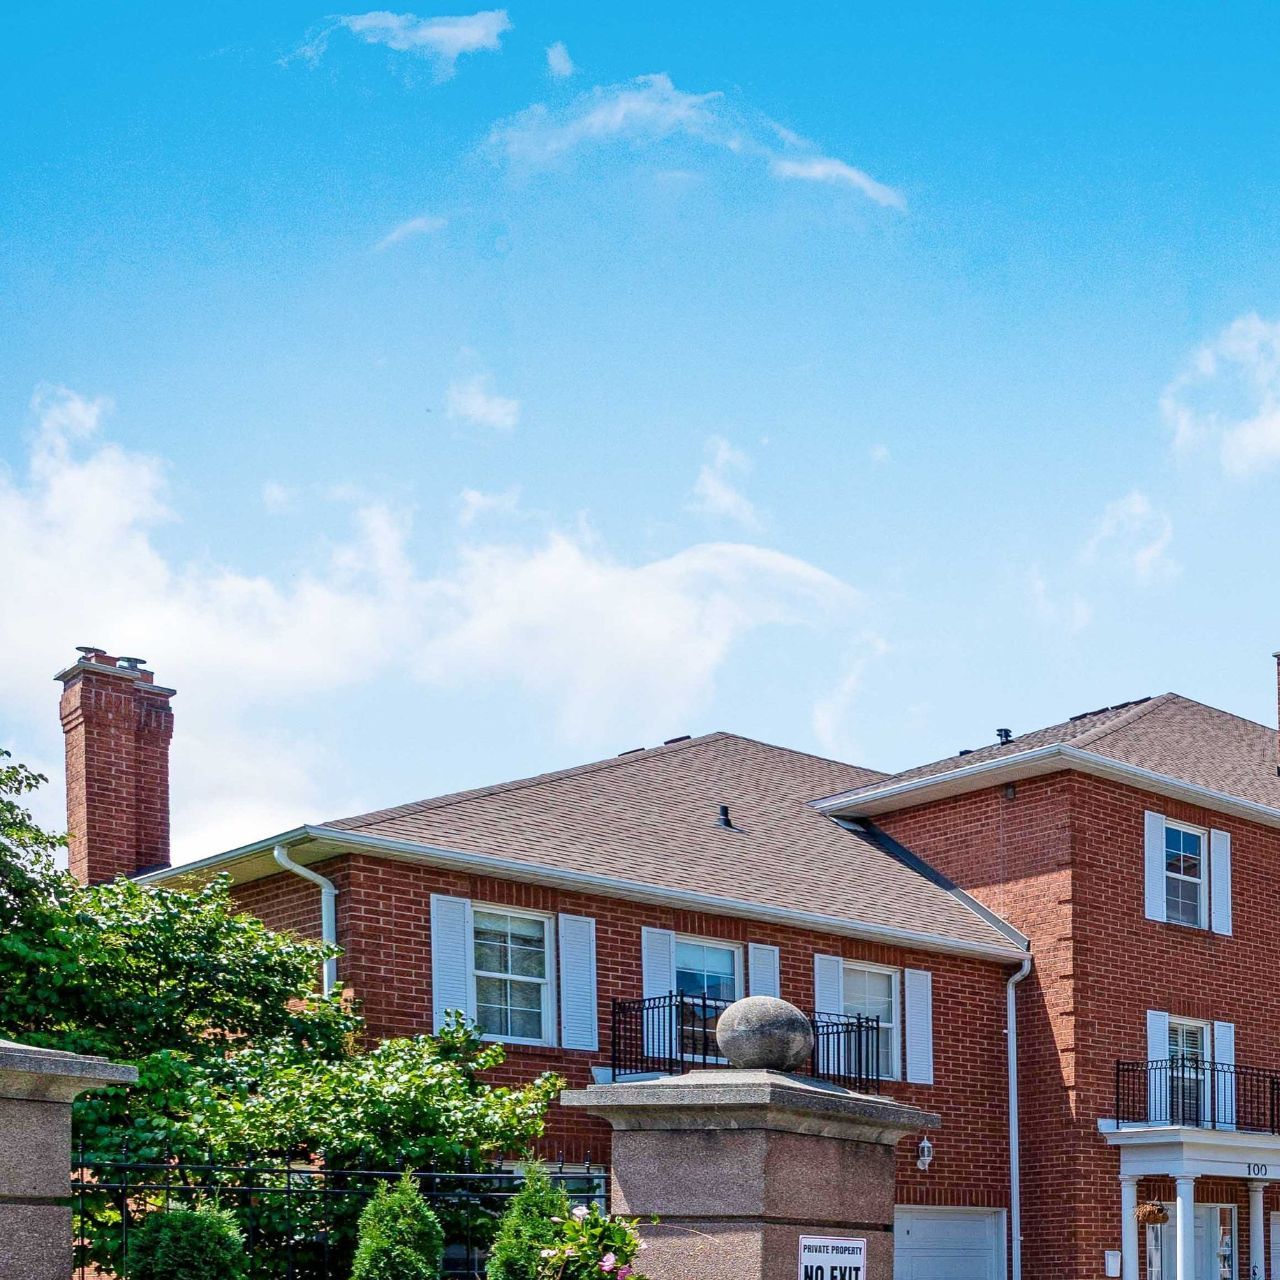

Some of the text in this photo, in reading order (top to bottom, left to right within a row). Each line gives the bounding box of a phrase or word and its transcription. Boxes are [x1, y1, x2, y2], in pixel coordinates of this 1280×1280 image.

[1247, 1163, 1268, 1176] 100
[803, 1244, 862, 1255] PRIVATE PROPERTY
